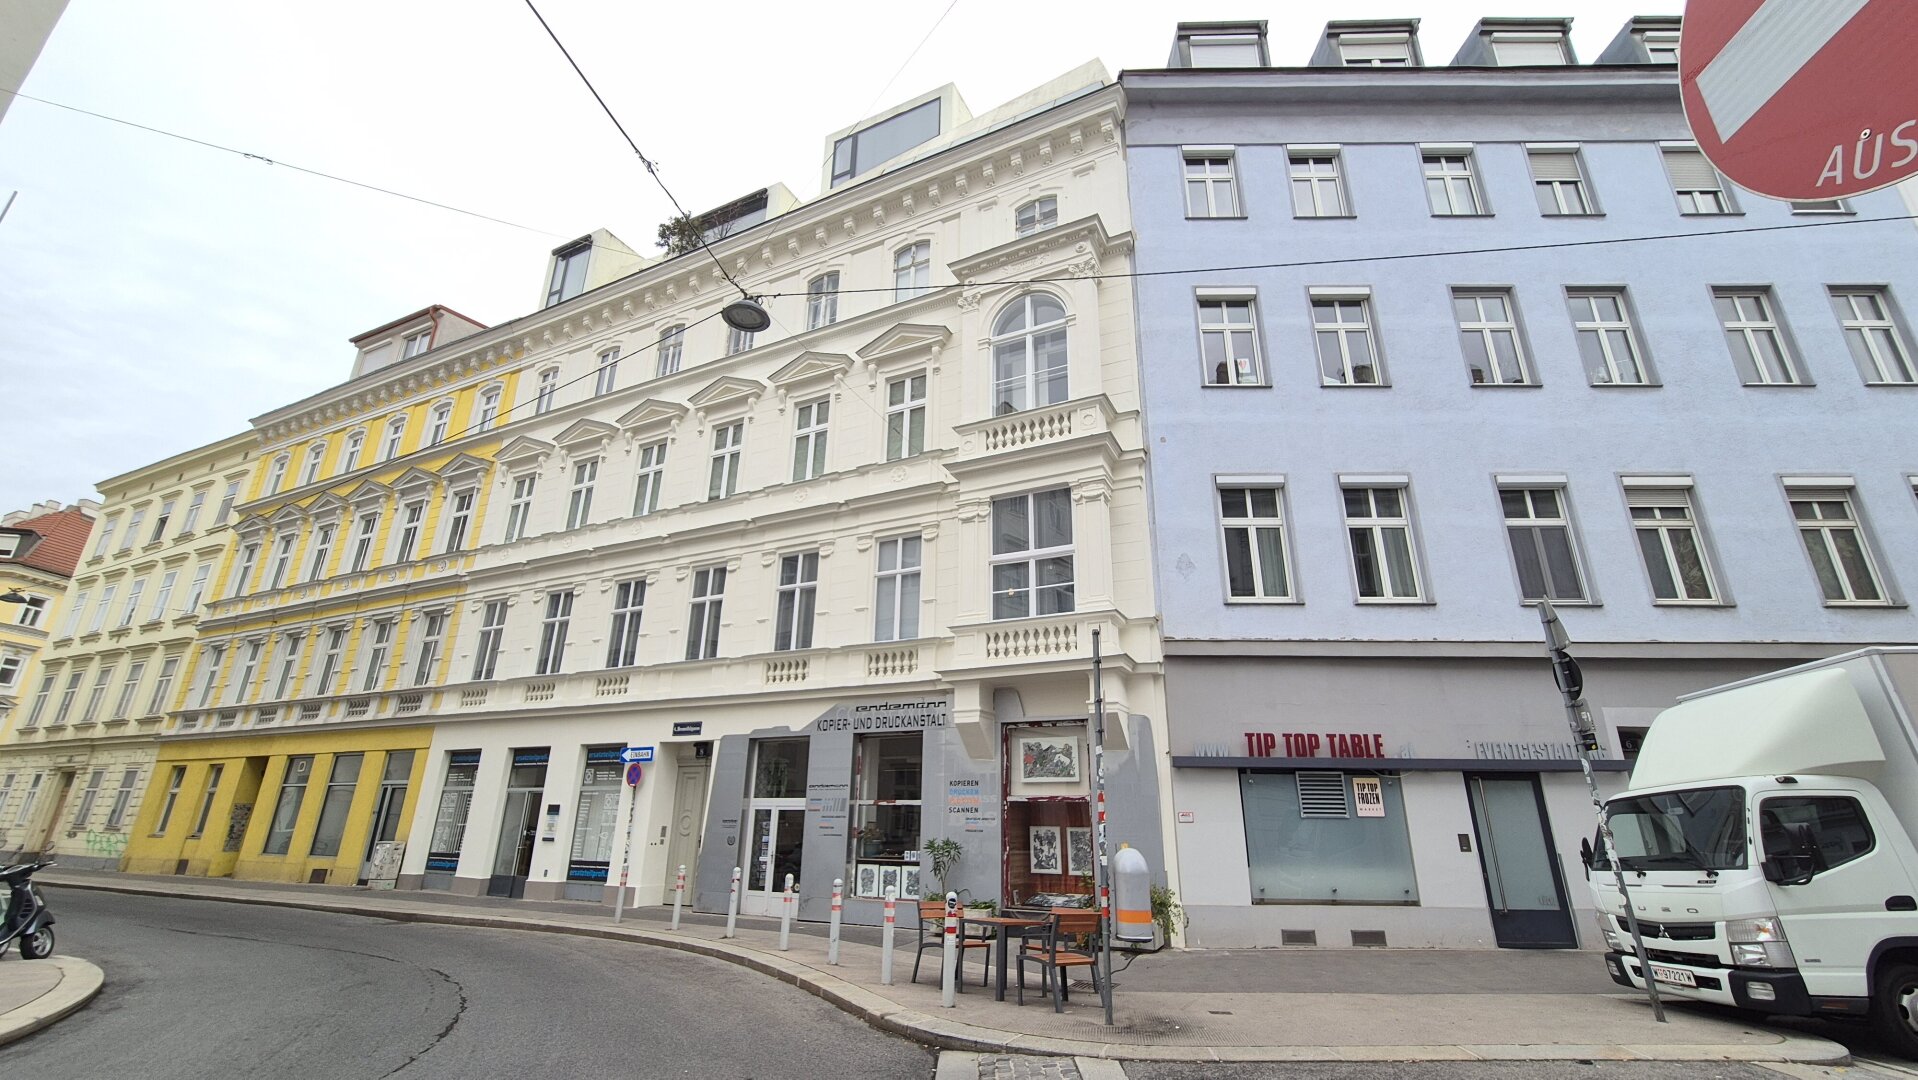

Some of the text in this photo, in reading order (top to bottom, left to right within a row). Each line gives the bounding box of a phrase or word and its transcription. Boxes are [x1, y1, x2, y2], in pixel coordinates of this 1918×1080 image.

[1815, 119, 1918, 187] AUS
[856, 701, 946, 712] endemann
[817, 719, 850, 732] KOPIER-
[853, 716, 872, 730] UND
[875, 713, 947, 729] DRUCKANSTALT
[1244, 732, 1276, 757] TIP
[1282, 733, 1320, 758] TOP
[1326, 733, 1385, 758] TABLE
[1625, 740, 1632, 749] 6
[630, 751, 650, 759] EINBAHN
[1475, 742, 1606, 760] EVENTGESTALTNG
[1356, 782, 1378, 793] TIP TOP
[1358, 792, 1381, 805] FROZEN
[948, 806, 979, 814] SCANNEN
